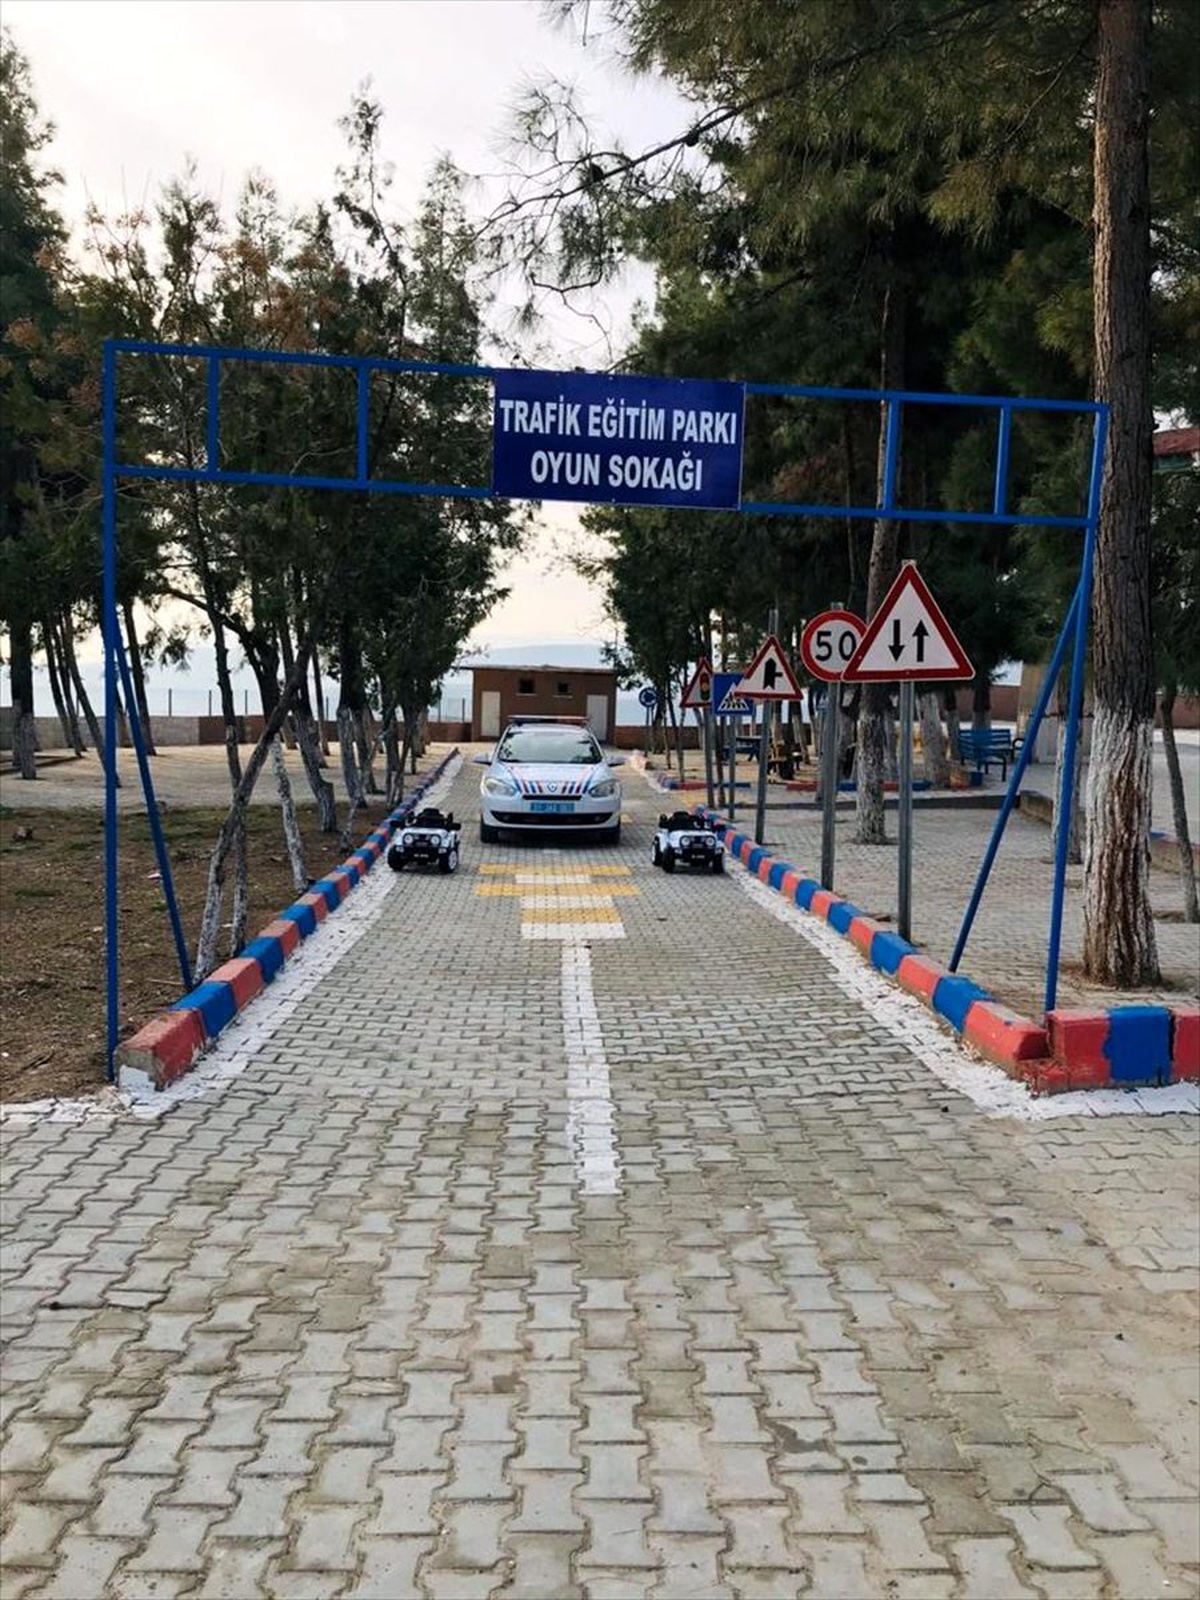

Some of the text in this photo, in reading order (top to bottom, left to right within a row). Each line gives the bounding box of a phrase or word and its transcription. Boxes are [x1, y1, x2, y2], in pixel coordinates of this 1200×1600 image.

[499, 395, 737, 444] TRAFİK EĞİTİM PARKI
[531, 450, 703, 491] OYUN SOKAĞI
[815, 630, 857, 661] 50
